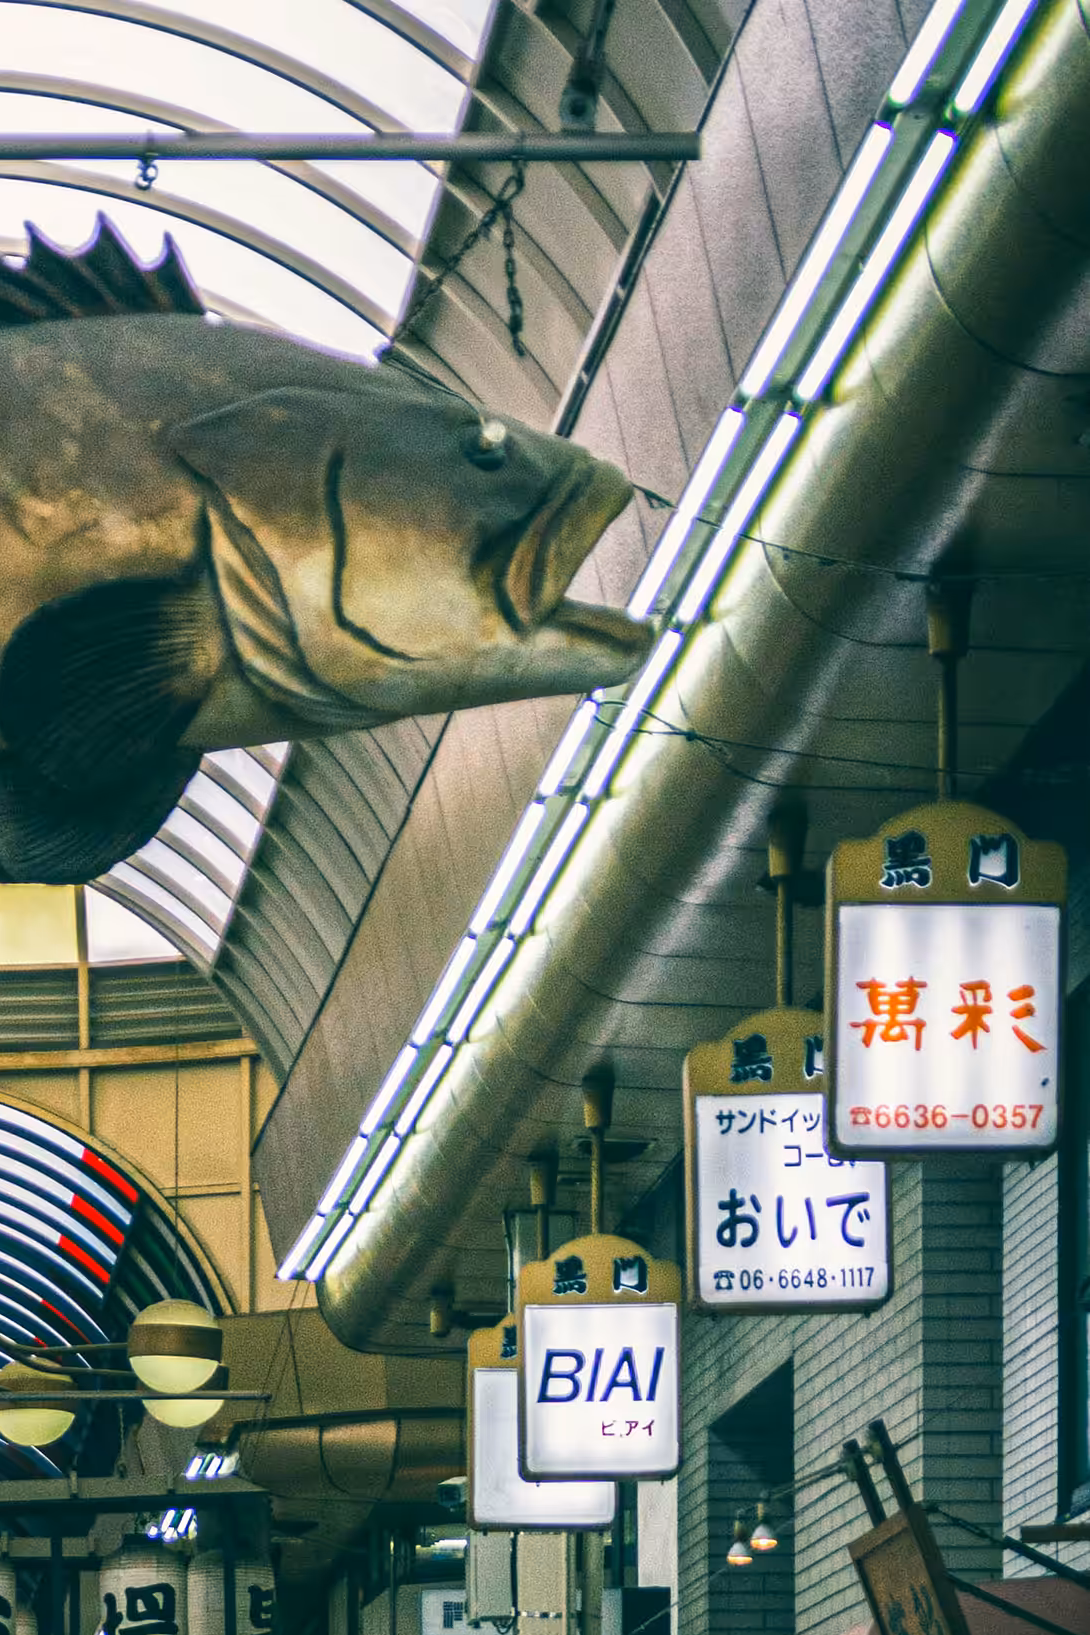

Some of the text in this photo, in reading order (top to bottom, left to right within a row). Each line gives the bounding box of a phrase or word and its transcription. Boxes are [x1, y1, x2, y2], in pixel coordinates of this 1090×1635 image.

[880, 829, 1023, 889] 黒門
[849, 976, 1049, 1054] 萬彩
[715, 1108, 822, 1135] サンドイッ
[874, 1104, 1045, 1129] 6636-0357
[783, 1144, 856, 1168] コー
[715, 1187, 871, 1249] おいで
[552, 1254, 649, 1295] 黒門
[536, 1346, 666, 1404] BIAI
